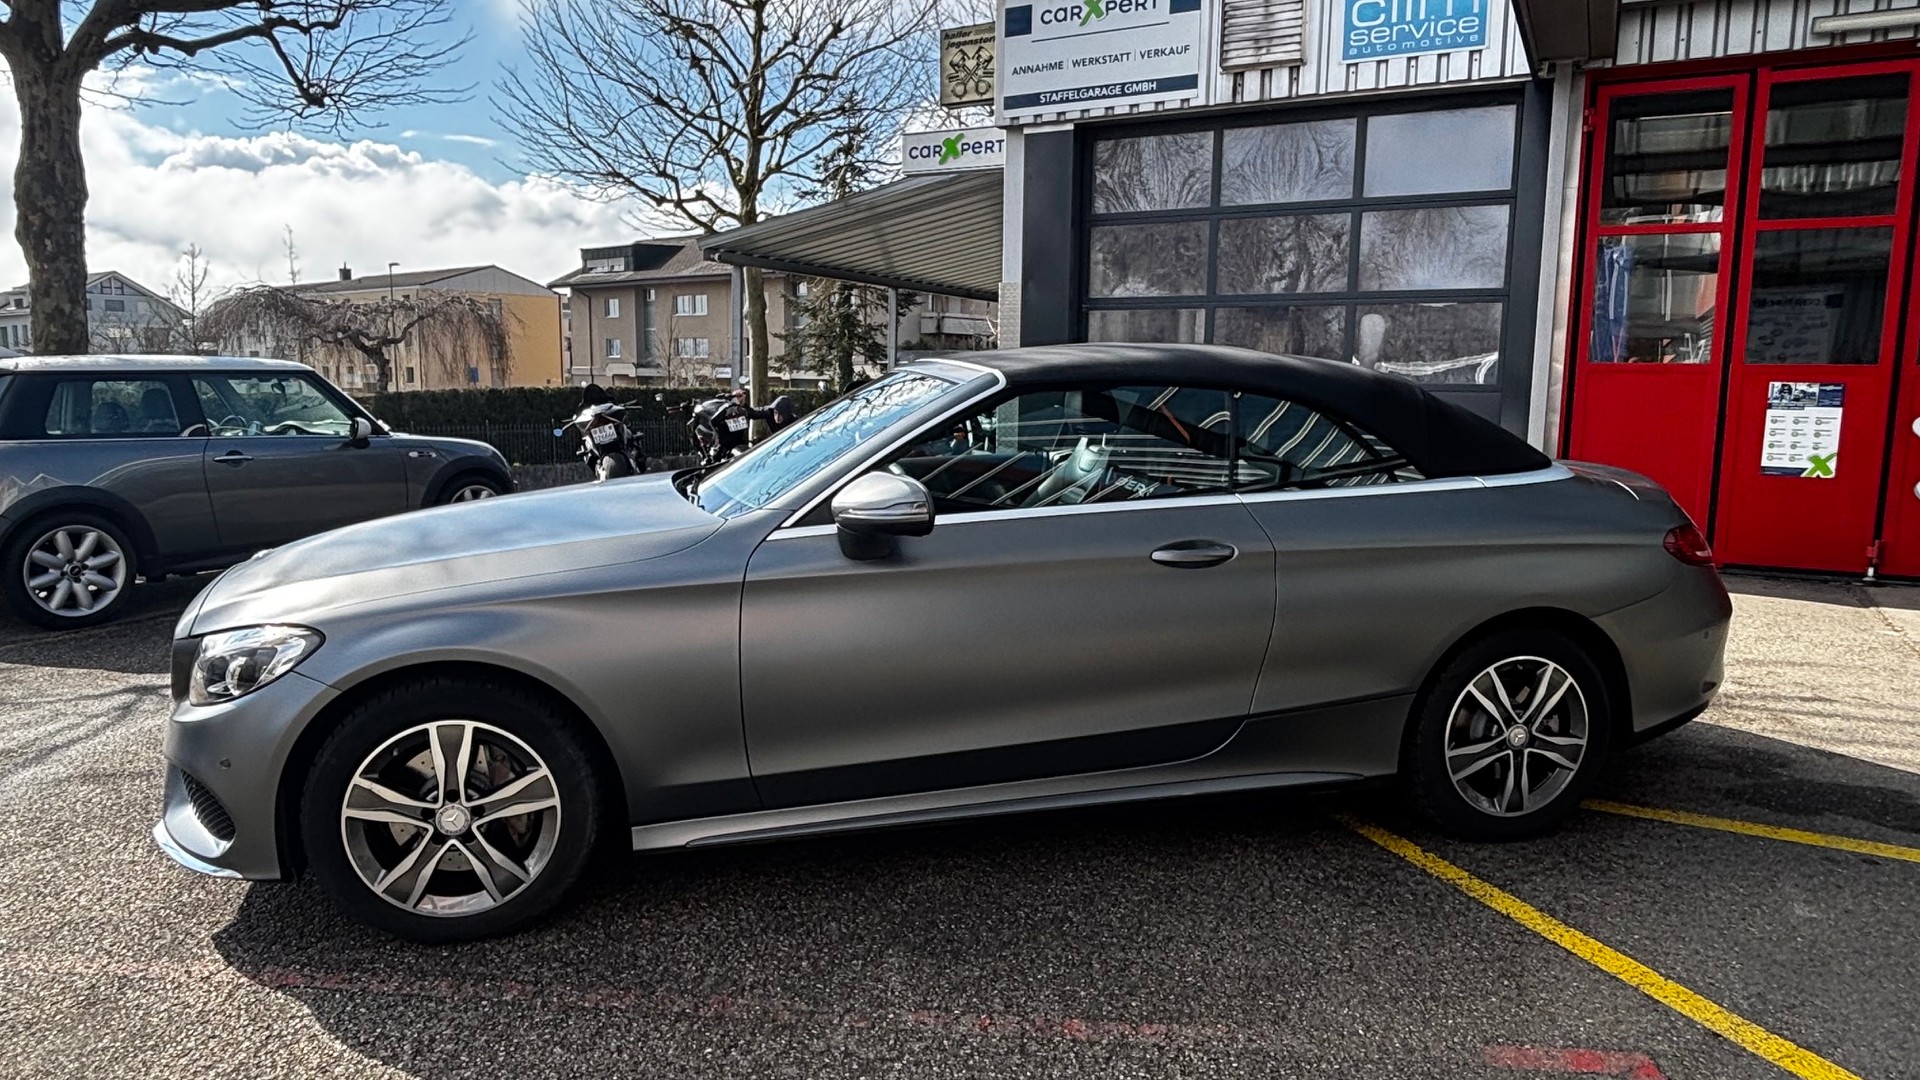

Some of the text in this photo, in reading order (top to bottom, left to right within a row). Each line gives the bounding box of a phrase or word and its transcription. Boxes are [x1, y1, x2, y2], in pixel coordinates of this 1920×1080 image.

[1350, 16, 1479, 46] service
[1349, 34, 1478, 55] automotive
[1012, 45, 1190, 76] ANNAHME WERKSTATT VERKAUF
[1039, 81, 1157, 103] STAFFELGARAGE GMBH
